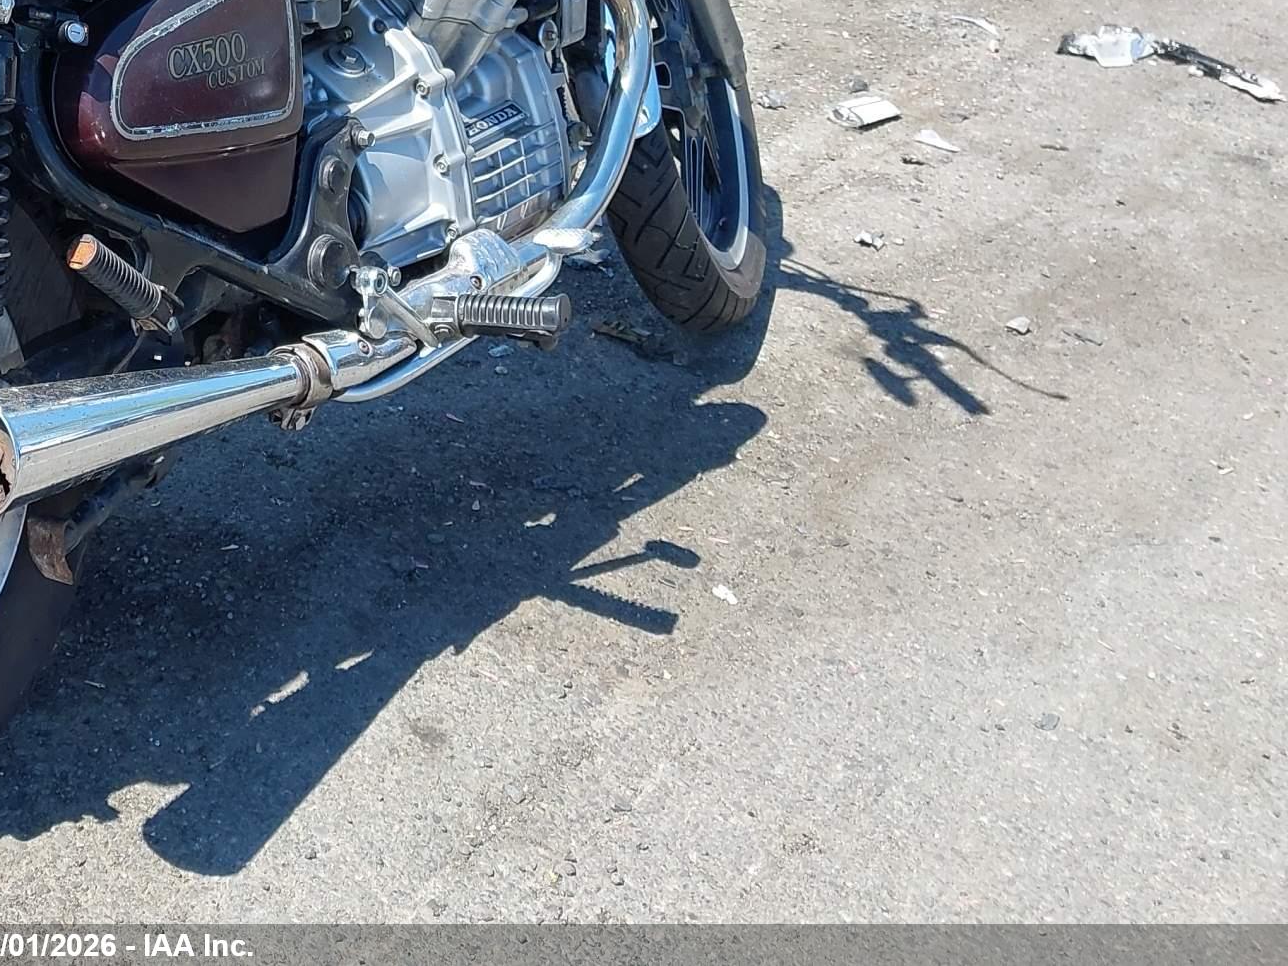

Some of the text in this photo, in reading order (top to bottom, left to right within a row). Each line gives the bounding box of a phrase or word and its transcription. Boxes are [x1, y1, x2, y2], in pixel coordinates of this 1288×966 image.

[168, 32, 247, 80] CX500
[208, 57, 266, 90] CUSTOM
[466, 107, 518, 137] HONDA
